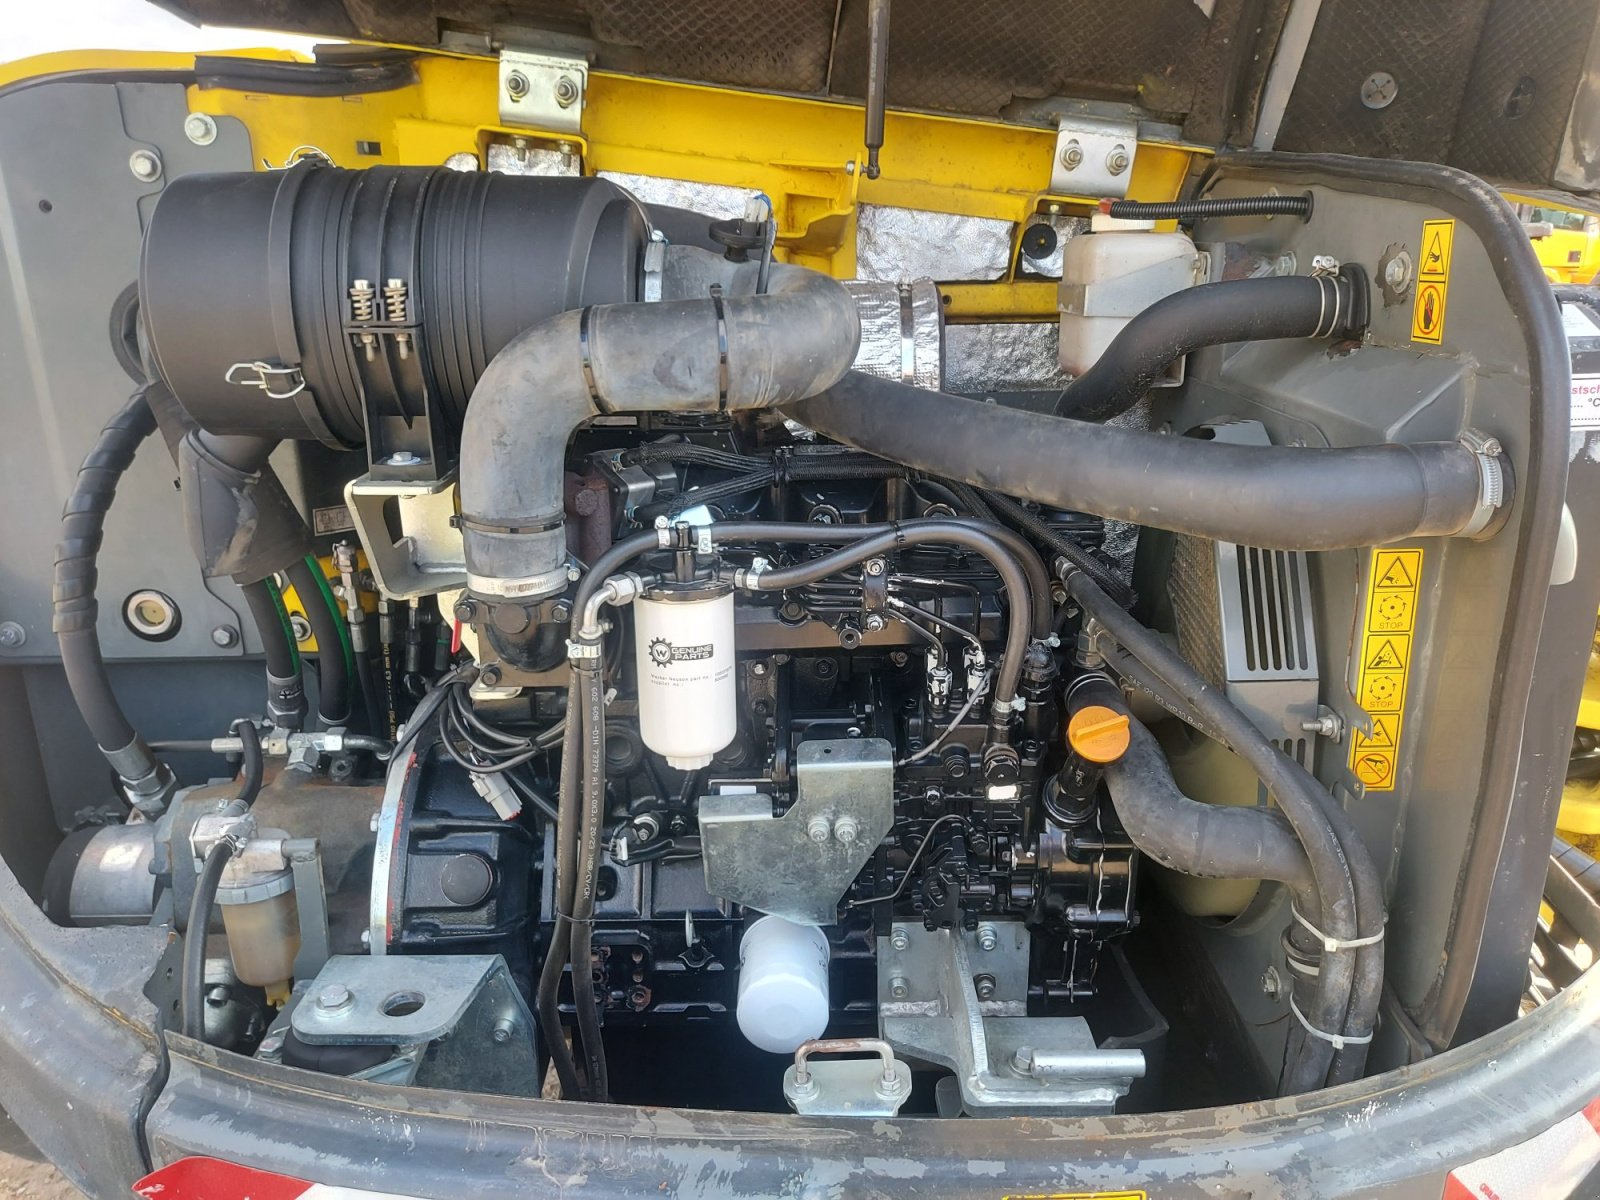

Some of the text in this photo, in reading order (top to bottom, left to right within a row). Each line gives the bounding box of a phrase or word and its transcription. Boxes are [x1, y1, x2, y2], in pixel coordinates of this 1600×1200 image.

[1379, 621, 1404, 630] STOP
[671, 644, 713, 654] GENUINE
[674, 651, 710, 660] PARTS
[1369, 700, 1394, 708] STOP
[588, 826, 597, 850] 20/23
